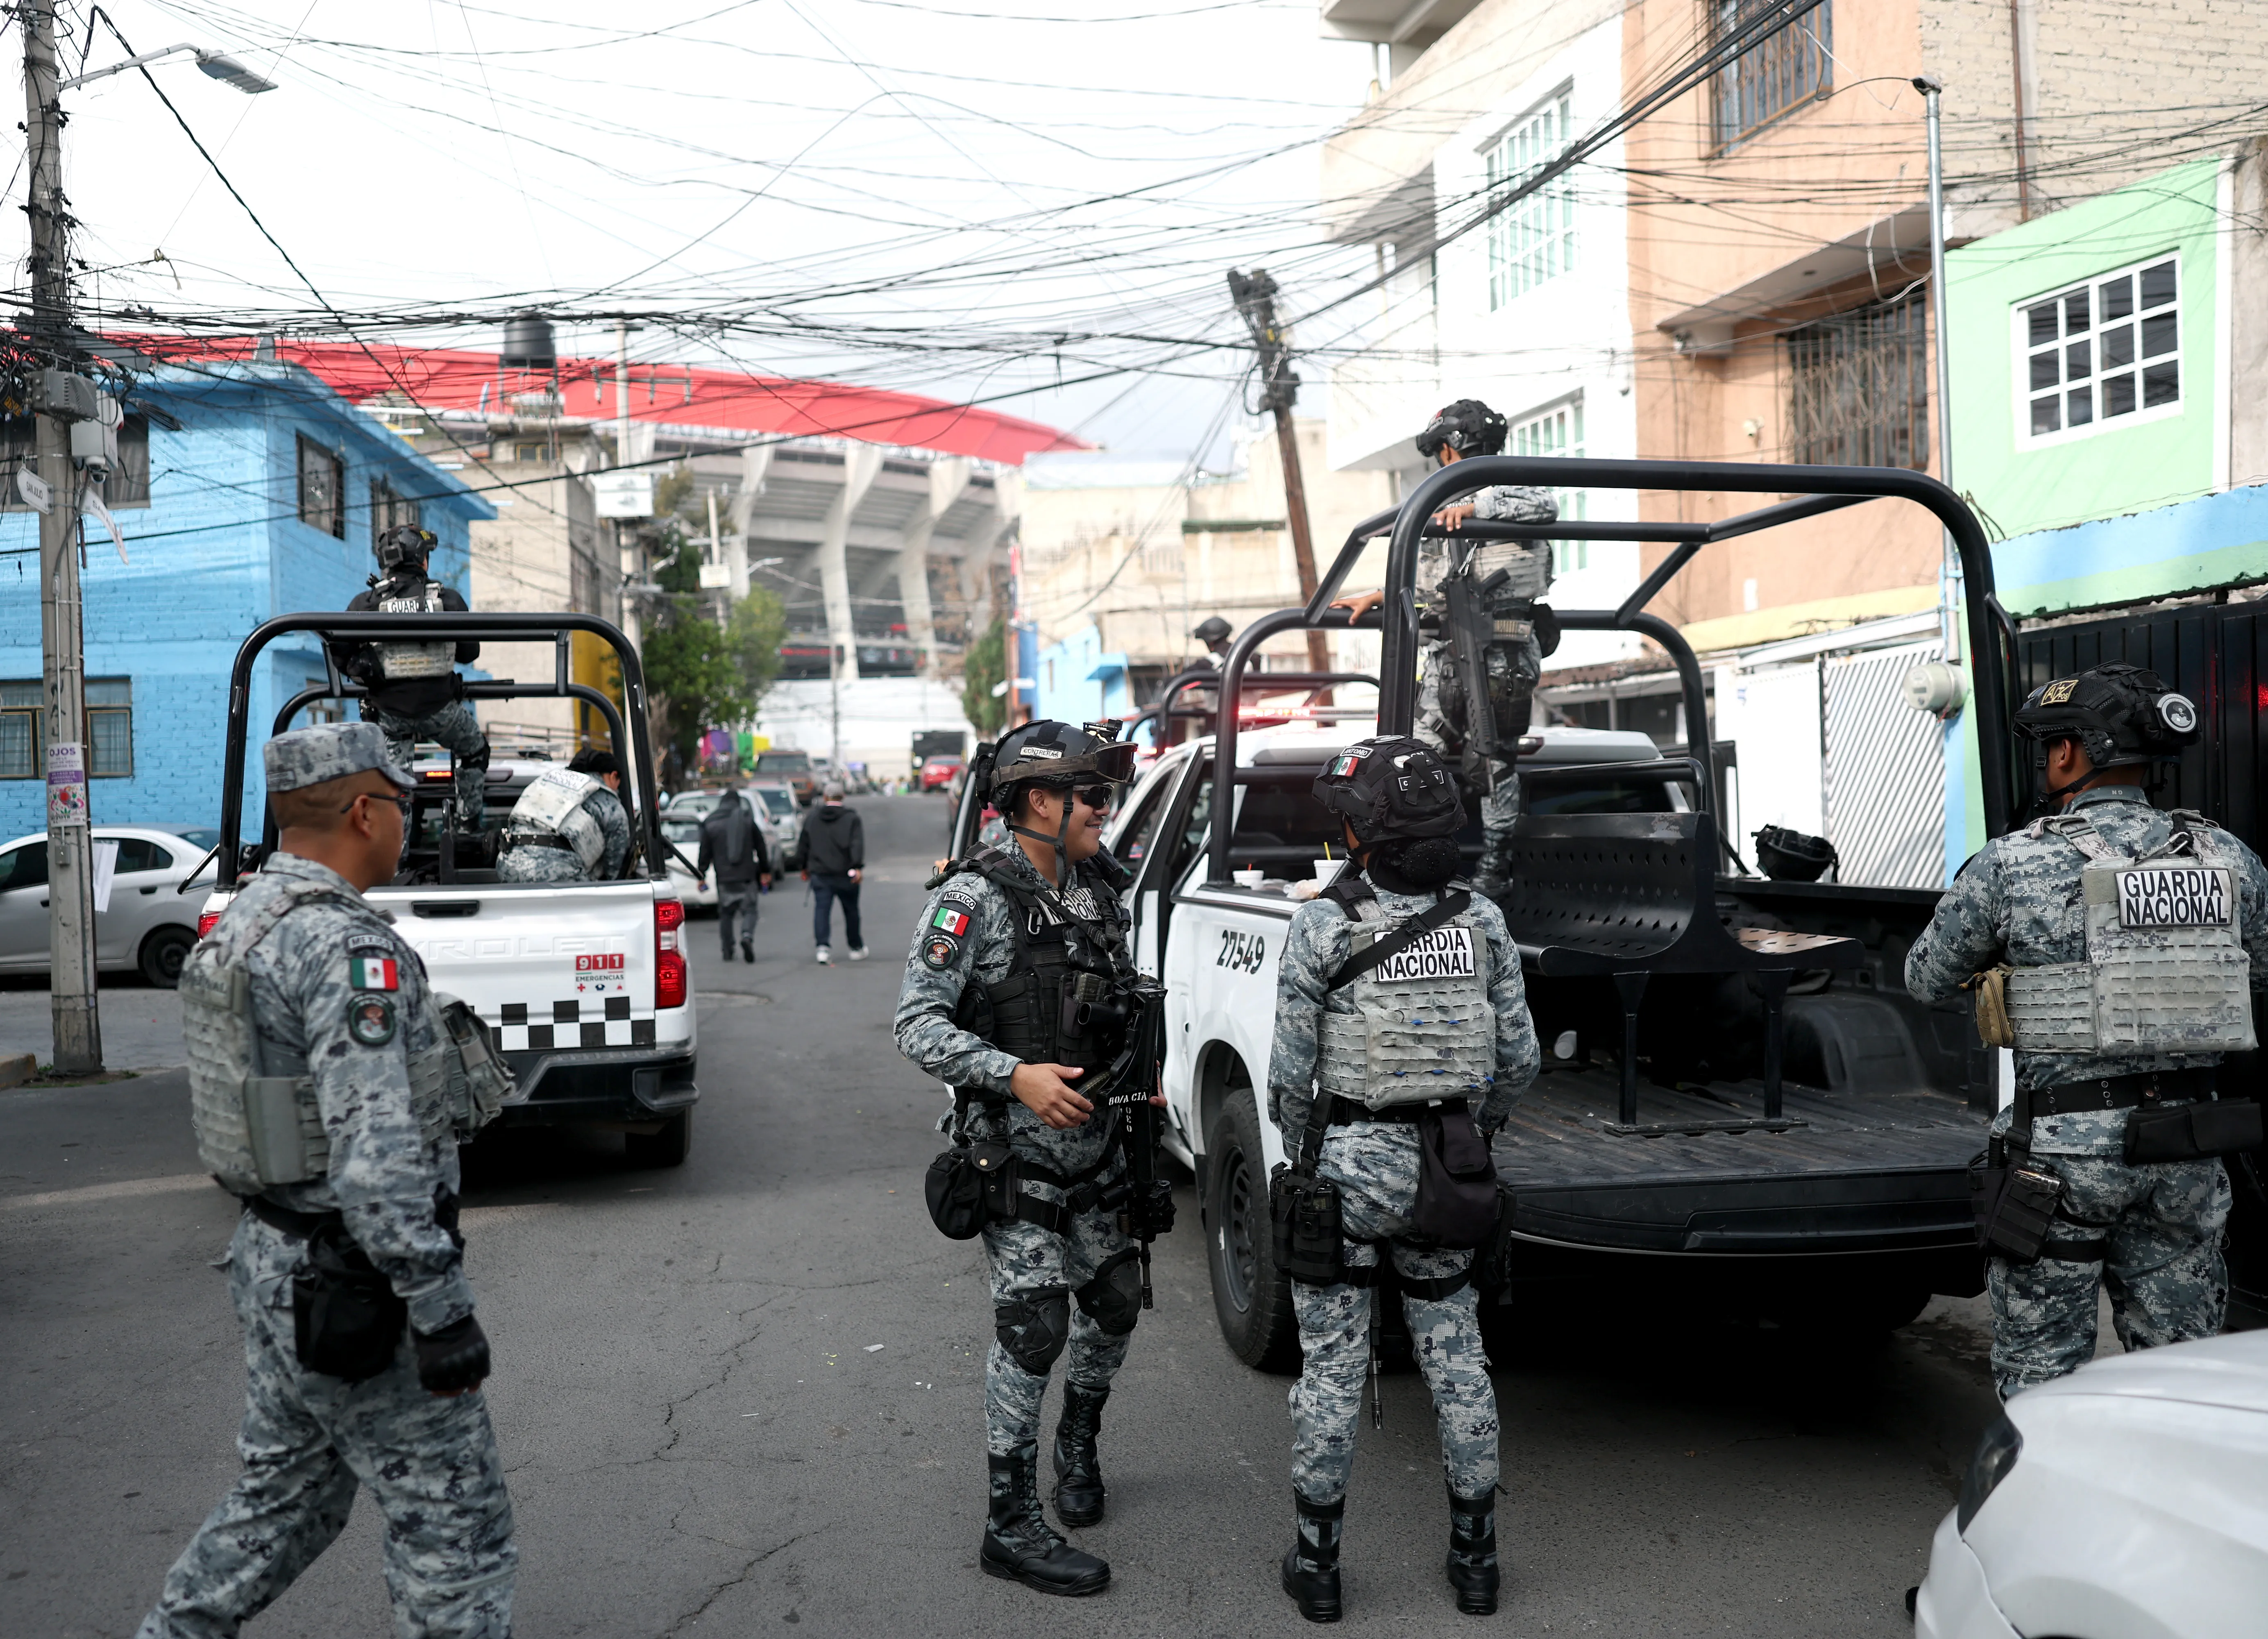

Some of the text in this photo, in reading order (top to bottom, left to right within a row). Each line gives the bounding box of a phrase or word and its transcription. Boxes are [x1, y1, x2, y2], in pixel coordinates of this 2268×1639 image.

[392, 599, 430, 613] GUARDA
[50, 747, 75, 757] OJOS
[1023, 748, 1059, 758] CONTRERAS
[2124, 870, 2223, 898] GUARDIA
[946, 893, 975, 908] MEXICO
[2126, 897, 2227, 924] NACIONAL
[942, 935, 958, 951] MORELOS
[1383, 930, 1467, 954] ARDIA
[1216, 929, 1265, 974] 27549
[579, 955, 619, 969] 911
[1379, 952, 1473, 979] NACIONAL
[1131, 1092, 1147, 1101] CIA
